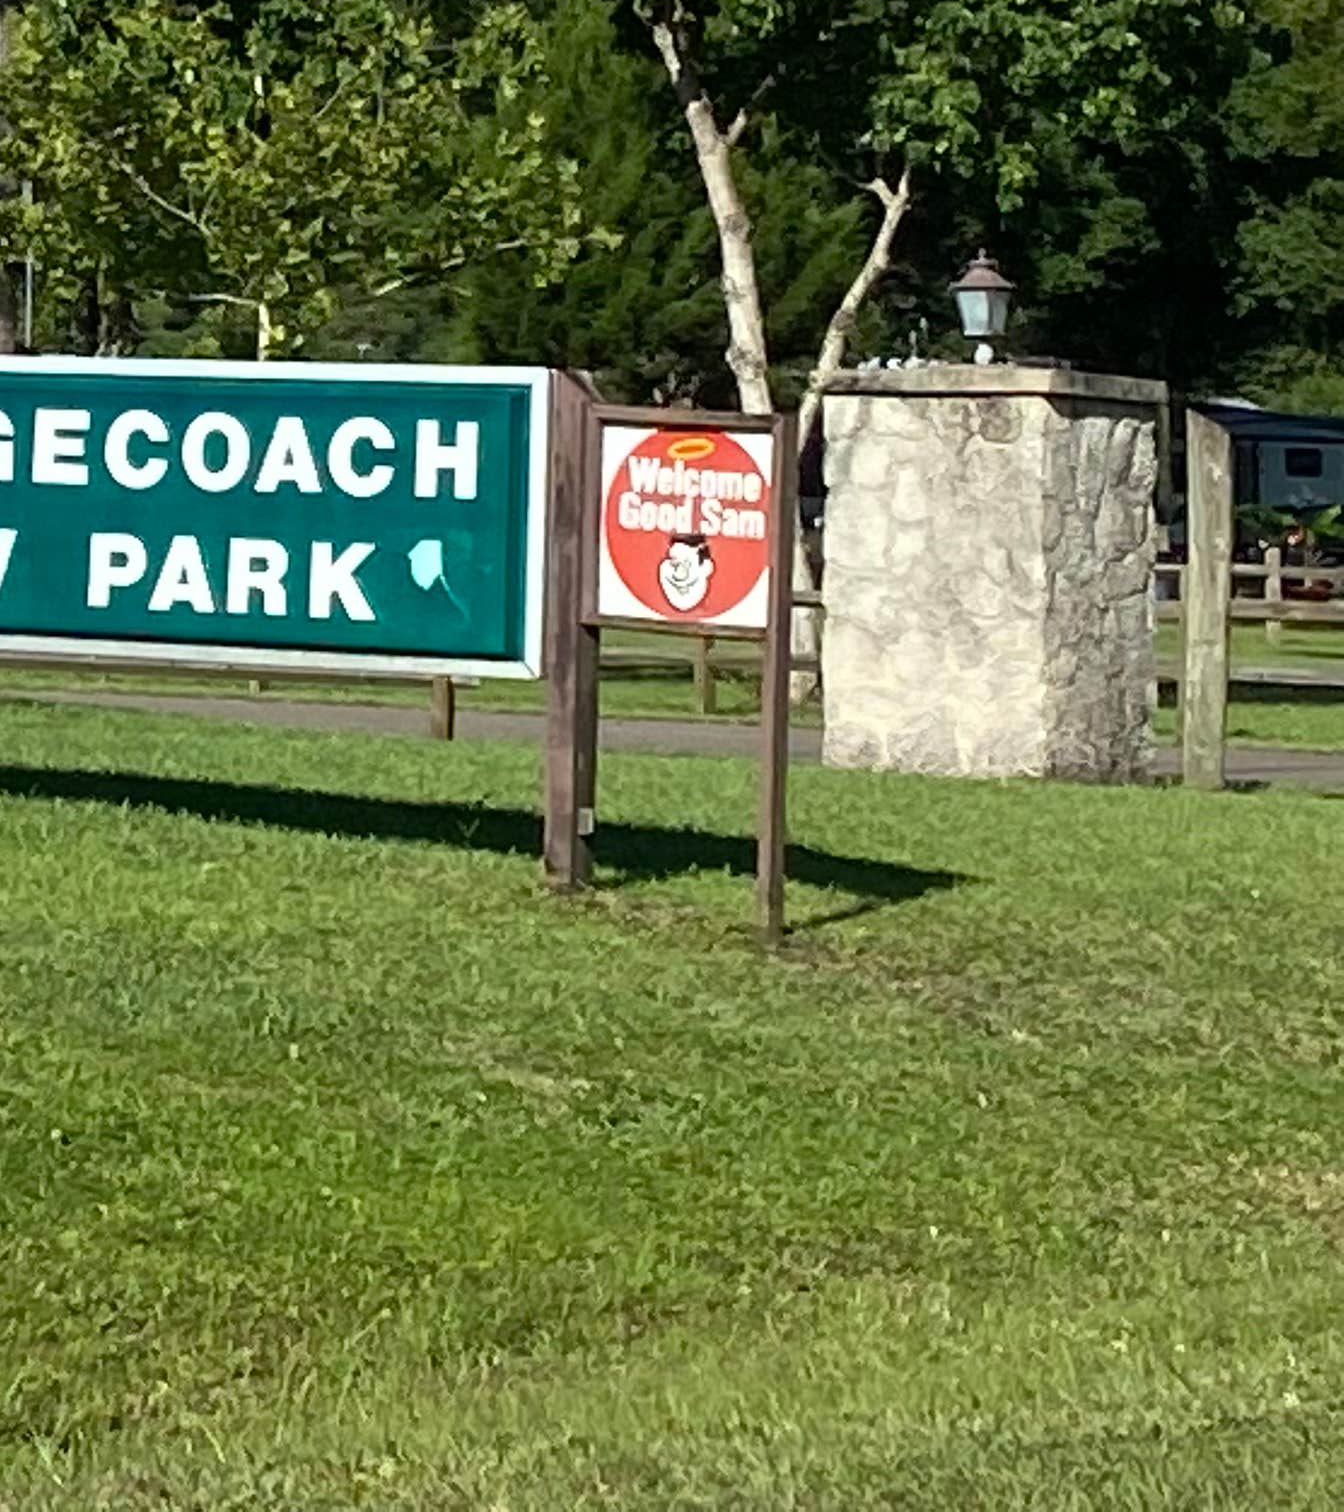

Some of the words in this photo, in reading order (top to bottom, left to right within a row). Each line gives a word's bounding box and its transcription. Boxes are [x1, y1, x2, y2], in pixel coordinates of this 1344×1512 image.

[627, 455, 763, 503] Welcome
[618, 491, 694, 535] Good
[699, 498, 766, 540] Sam
[87, 532, 377, 621] PARK
